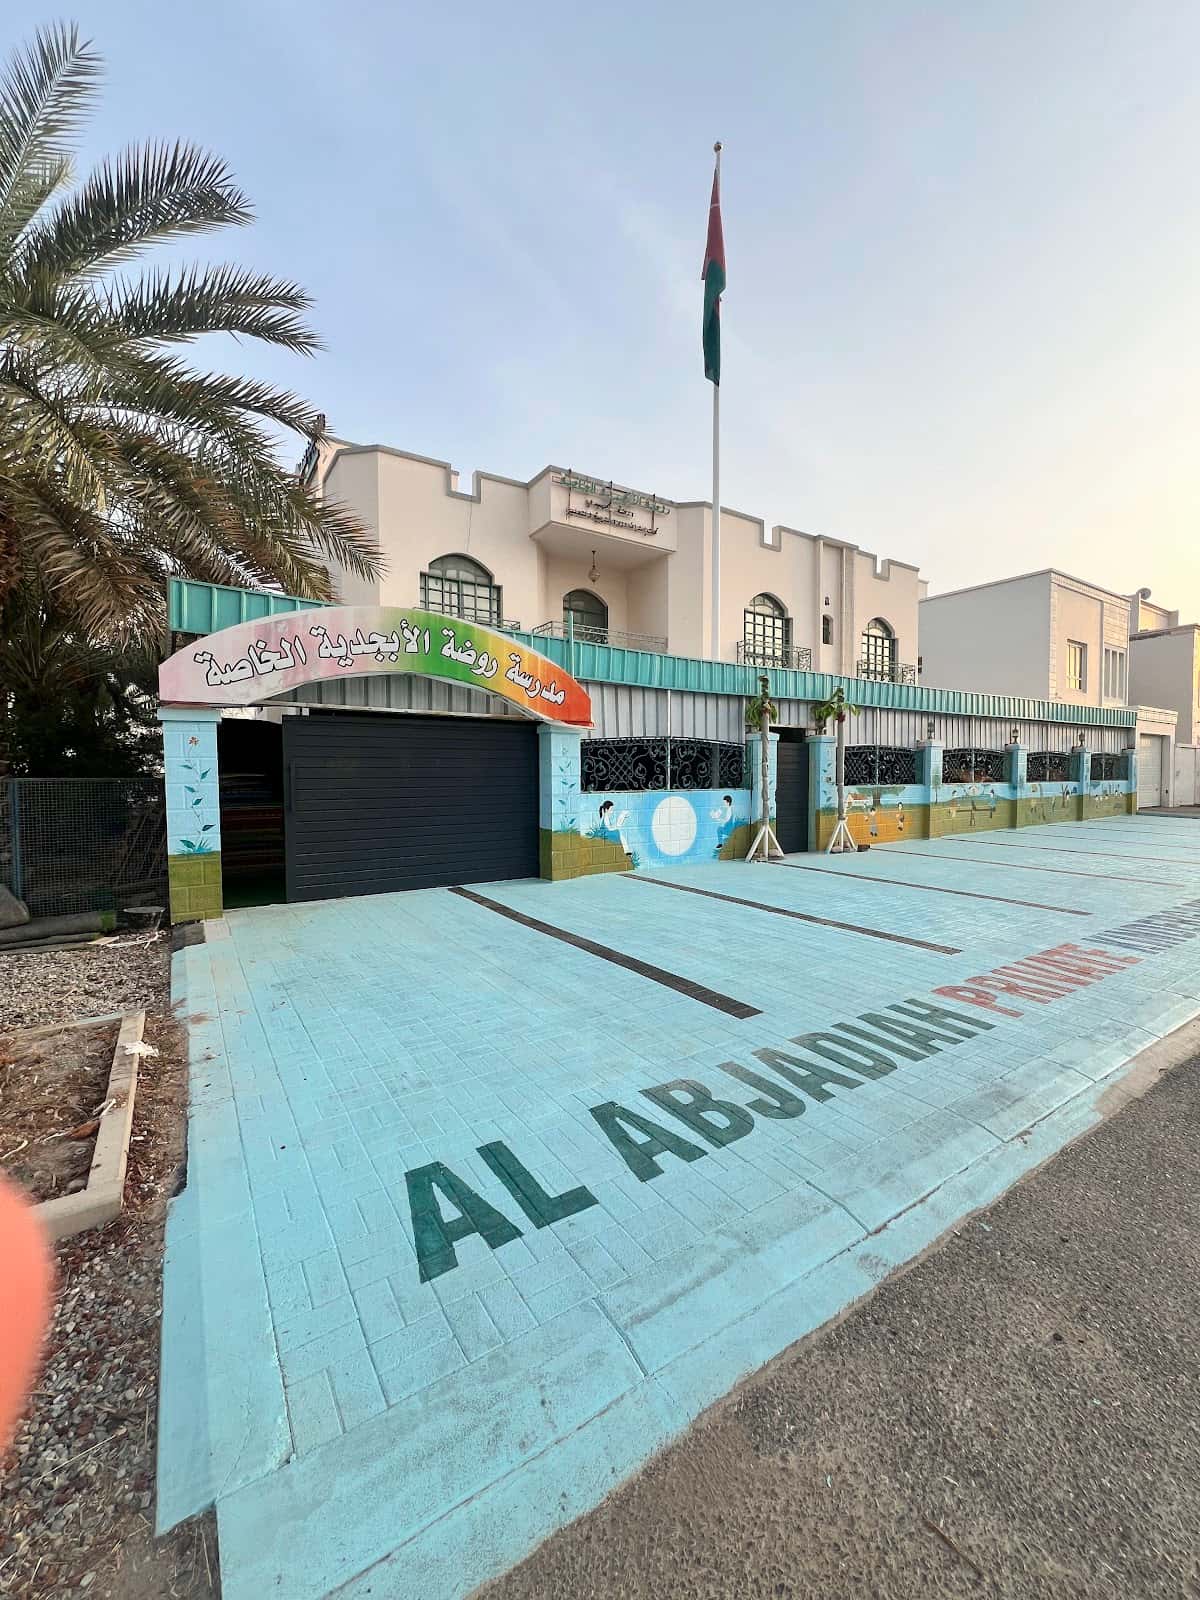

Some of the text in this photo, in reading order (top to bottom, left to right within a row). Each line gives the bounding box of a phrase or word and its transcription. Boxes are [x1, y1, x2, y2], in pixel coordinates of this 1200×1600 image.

[193, 618, 566, 706] مدرسة روضة الأبجدية الخاصة
[404, 1140, 599, 1284] AL
[588, 998, 996, 1183] ABJADIAH
[930, 942, 1145, 1019] PRIVATE
